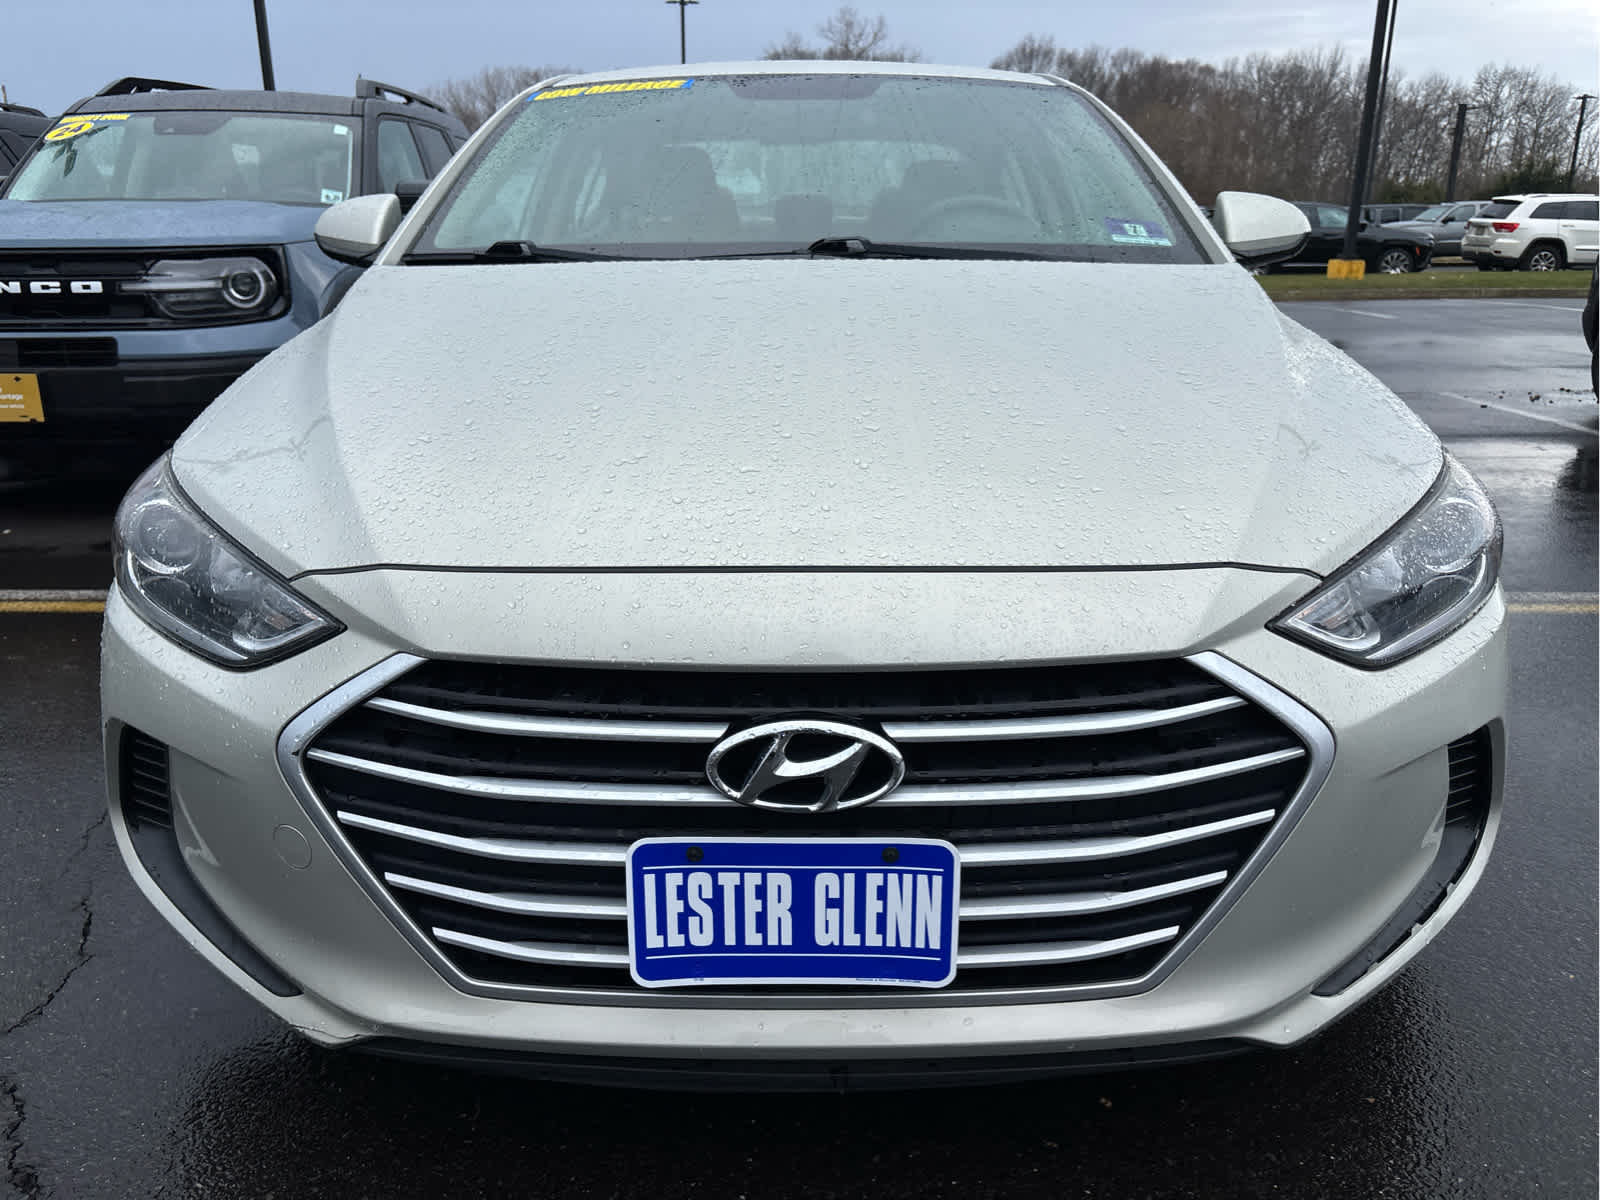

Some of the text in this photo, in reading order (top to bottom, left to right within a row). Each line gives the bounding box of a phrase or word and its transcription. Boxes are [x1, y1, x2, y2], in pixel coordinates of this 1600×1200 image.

[534, 80, 688, 100] LOW MILEAGE
[643, 872, 943, 950] LESTER GLENN
